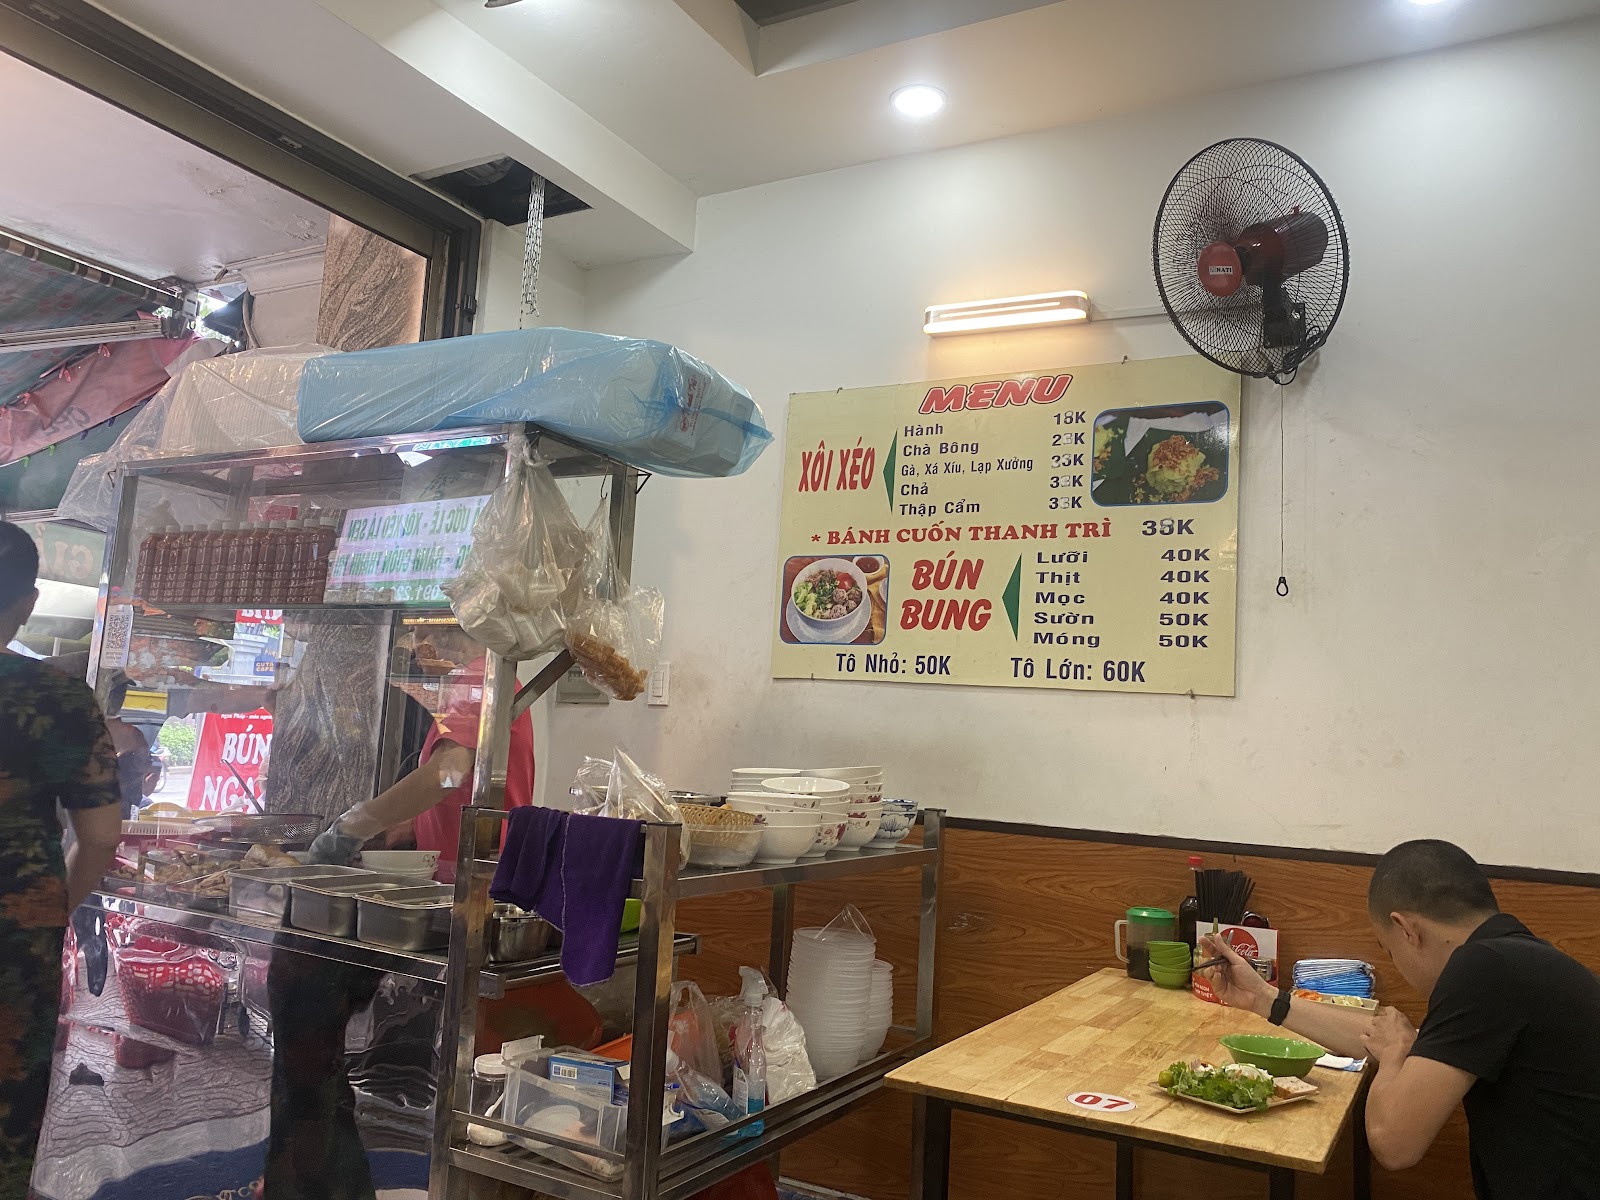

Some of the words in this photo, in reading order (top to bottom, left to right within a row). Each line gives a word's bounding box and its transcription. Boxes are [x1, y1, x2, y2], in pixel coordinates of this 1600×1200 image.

[918, 374, 1073, 414] MENU
[904, 423, 944, 437] Hành
[939, 442, 979, 455] Bông
[799, 440, 833, 493] XÔI
[836, 436, 875, 490] XÉO
[924, 463, 938, 475] Xá
[943, 461, 965, 475] Xíu,
[971, 460, 992, 474] Lạp
[996, 456, 1033, 472] Xưởng
[900, 482, 929, 496] Chả
[899, 503, 937, 517] Thập
[944, 498, 981, 514] Cẩm
[826, 526, 891, 545] BÁNH
[896, 520, 962, 543] CUỐN
[968, 524, 1058, 542] THANH
[1066, 518, 1112, 539] TRÌ
[1036, 550, 1088, 565] Lưỡi
[1160, 548, 1211, 562] 40K
[912, 550, 985, 591] BÚN
[1035, 571, 1081, 586] Thịt
[1160, 569, 1210, 584] 40K
[1035, 591, 1086, 607] Mọc
[1159, 591, 1210, 606] 40K
[900, 598, 992, 632] BUNG
[1034, 610, 1095, 625] Sườn
[1158, 612, 1209, 627] 50K
[1033, 631, 1100, 649] Móng
[1158, 634, 1208, 649] 50K
[836, 653, 857, 674] Tô
[864, 652, 908, 676] Nhỏ:
[914, 655, 951, 676] 50K
[1011, 656, 1035, 679] Tô
[1045, 658, 1093, 682] Lớn:
[1102, 660, 1146, 684] 60K
[222, 724, 273, 765] BÚN
[1074, 1094, 1129, 1109] 07
